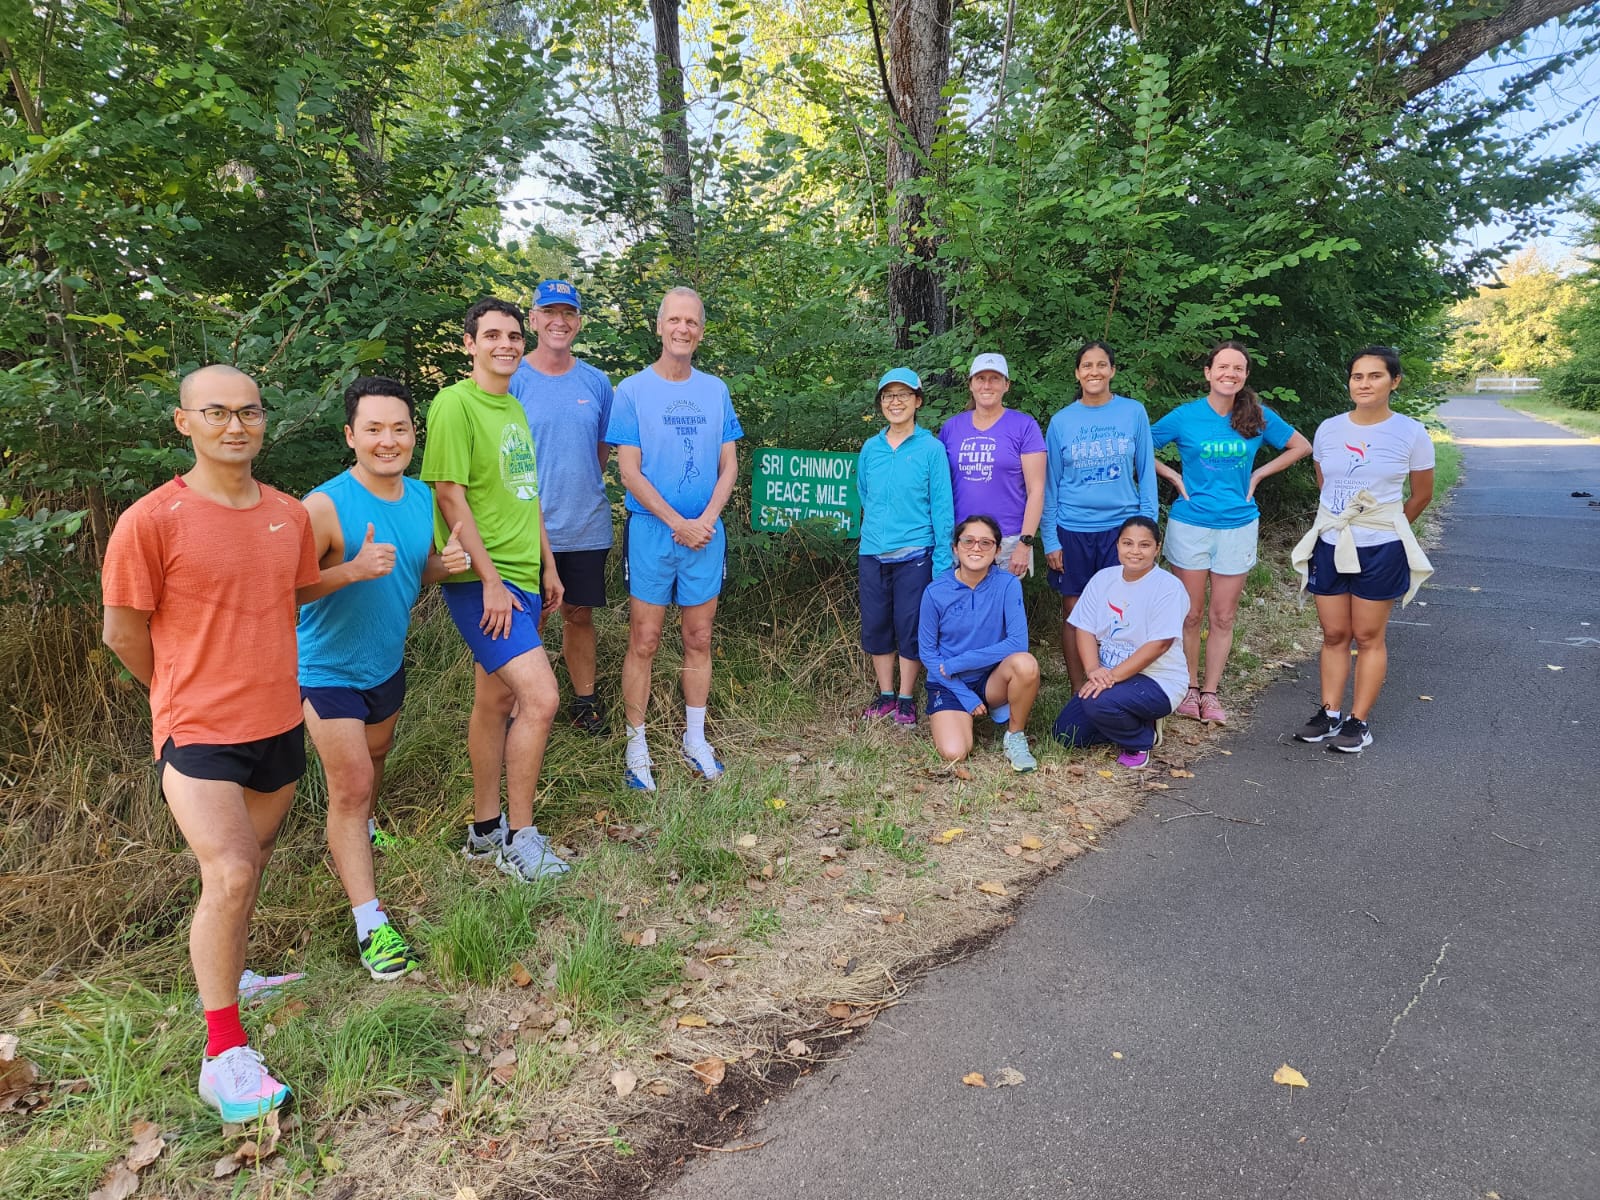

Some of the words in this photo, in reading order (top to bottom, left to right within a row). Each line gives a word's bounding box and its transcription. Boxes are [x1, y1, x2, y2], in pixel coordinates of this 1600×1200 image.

[662, 415, 707, 425] MARATHON
[675, 426, 698, 436] TEAM
[960, 442, 977, 451] let
[1071, 438, 1129, 460] HALF
[1200, 439, 1247, 459] 3100
[761, 454, 784, 476] SRI
[789, 455, 853, 480] CHINMOY
[766, 481, 811, 503] PEACE
[816, 484, 848, 506] MILE
